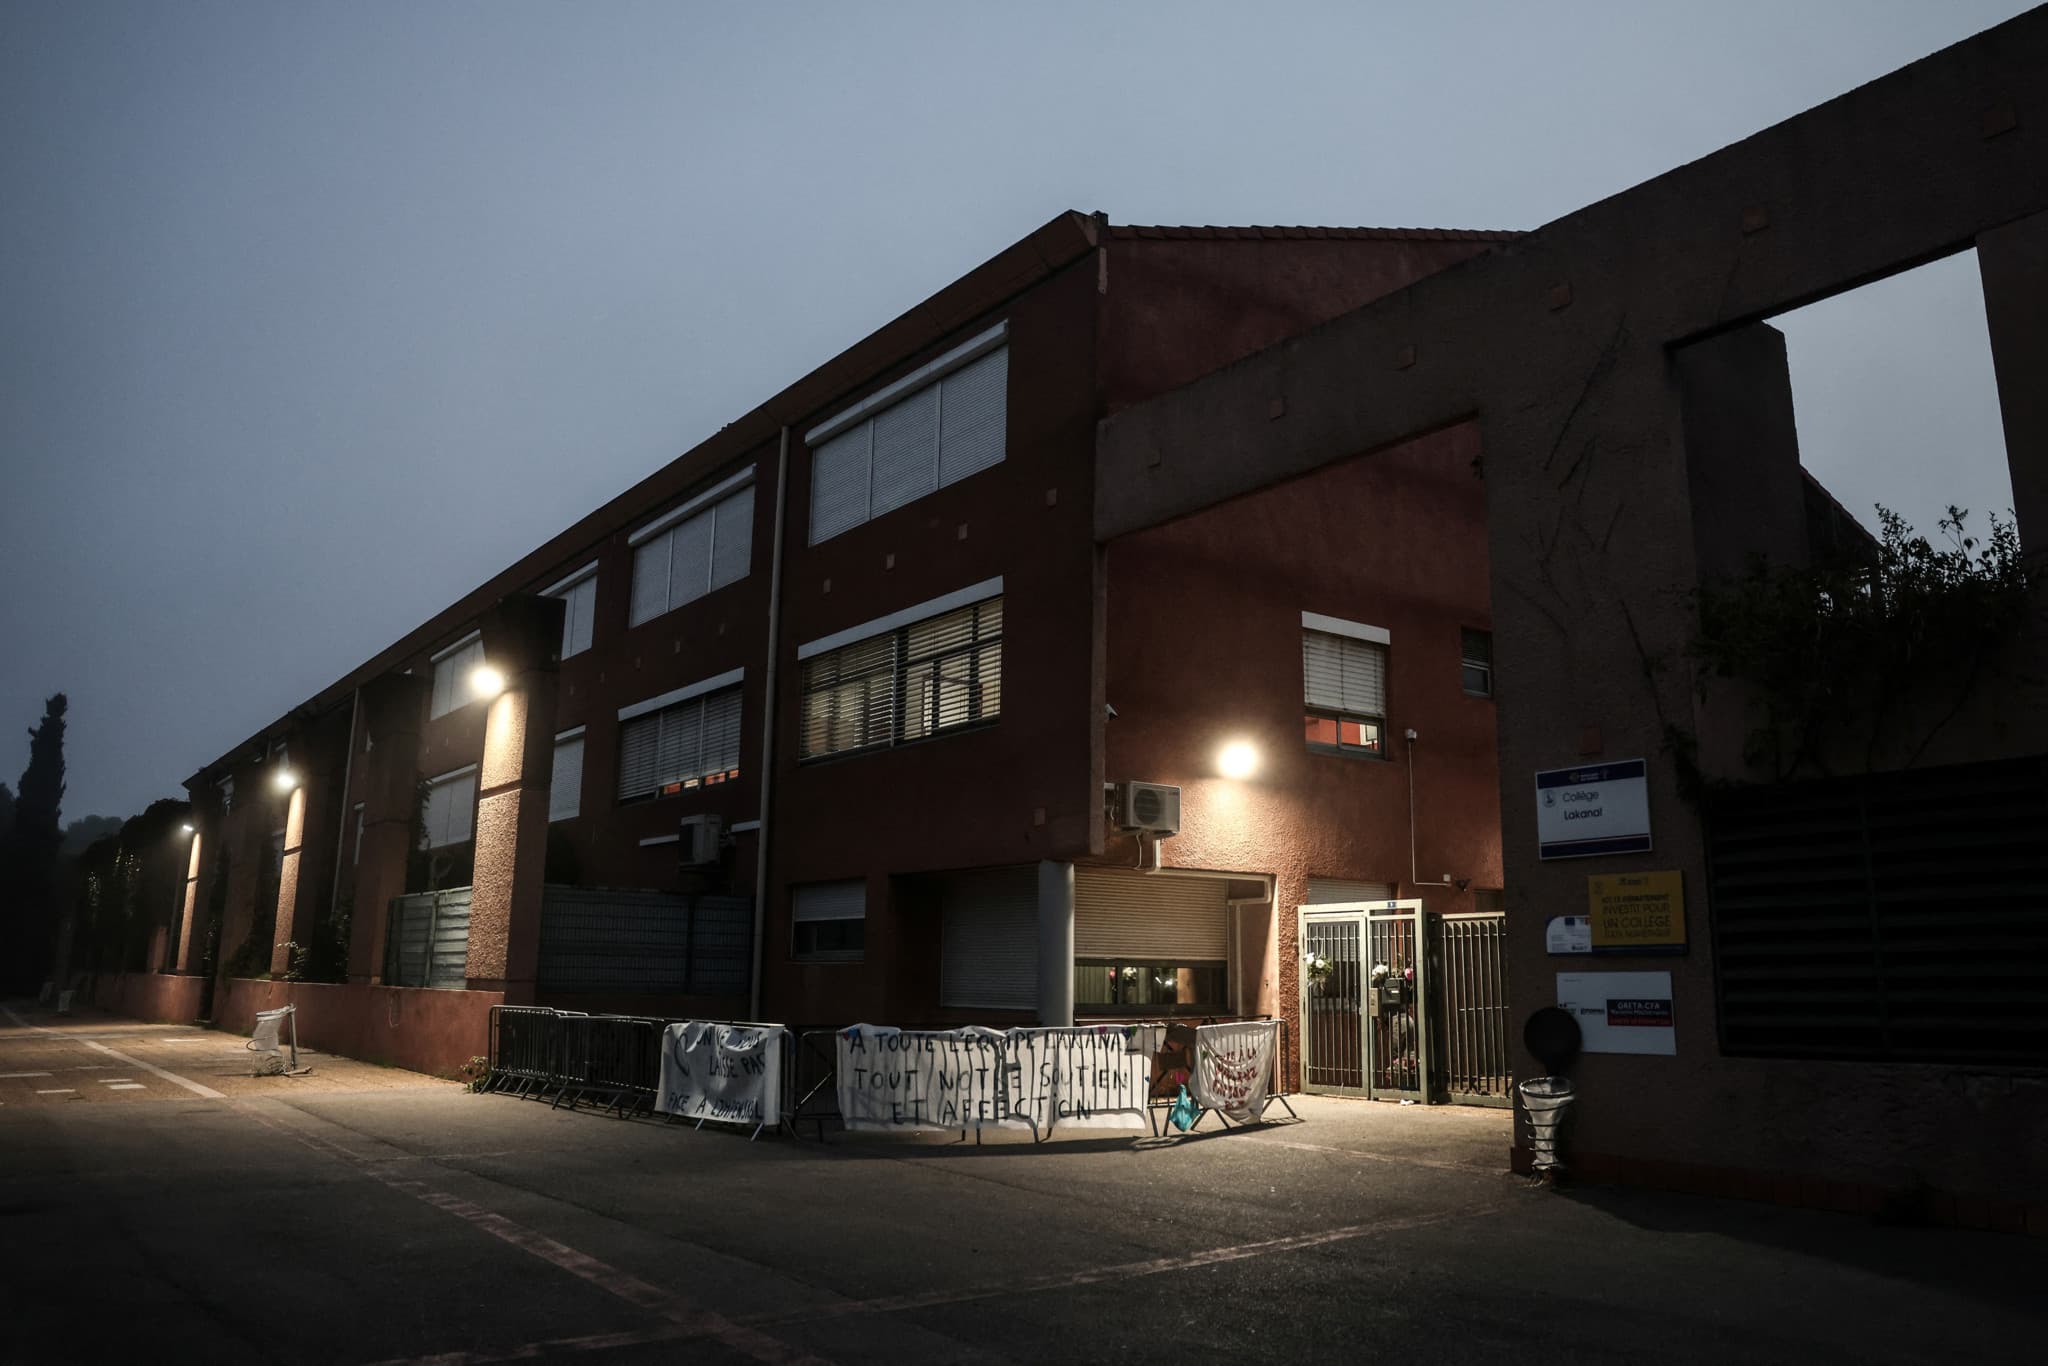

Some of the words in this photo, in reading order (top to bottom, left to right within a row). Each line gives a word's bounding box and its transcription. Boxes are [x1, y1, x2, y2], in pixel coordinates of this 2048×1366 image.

[1562, 790, 1600, 803] Collège
[1563, 807, 1604, 821] Lakanal
[875, 1033, 938, 1053] TOUTE
[854, 1068, 918, 1090] TOUT
[939, 1066, 1022, 1091] NOTE
[1040, 1062, 1127, 1089] SOUTIEN
[892, 1099, 927, 1125] ET
